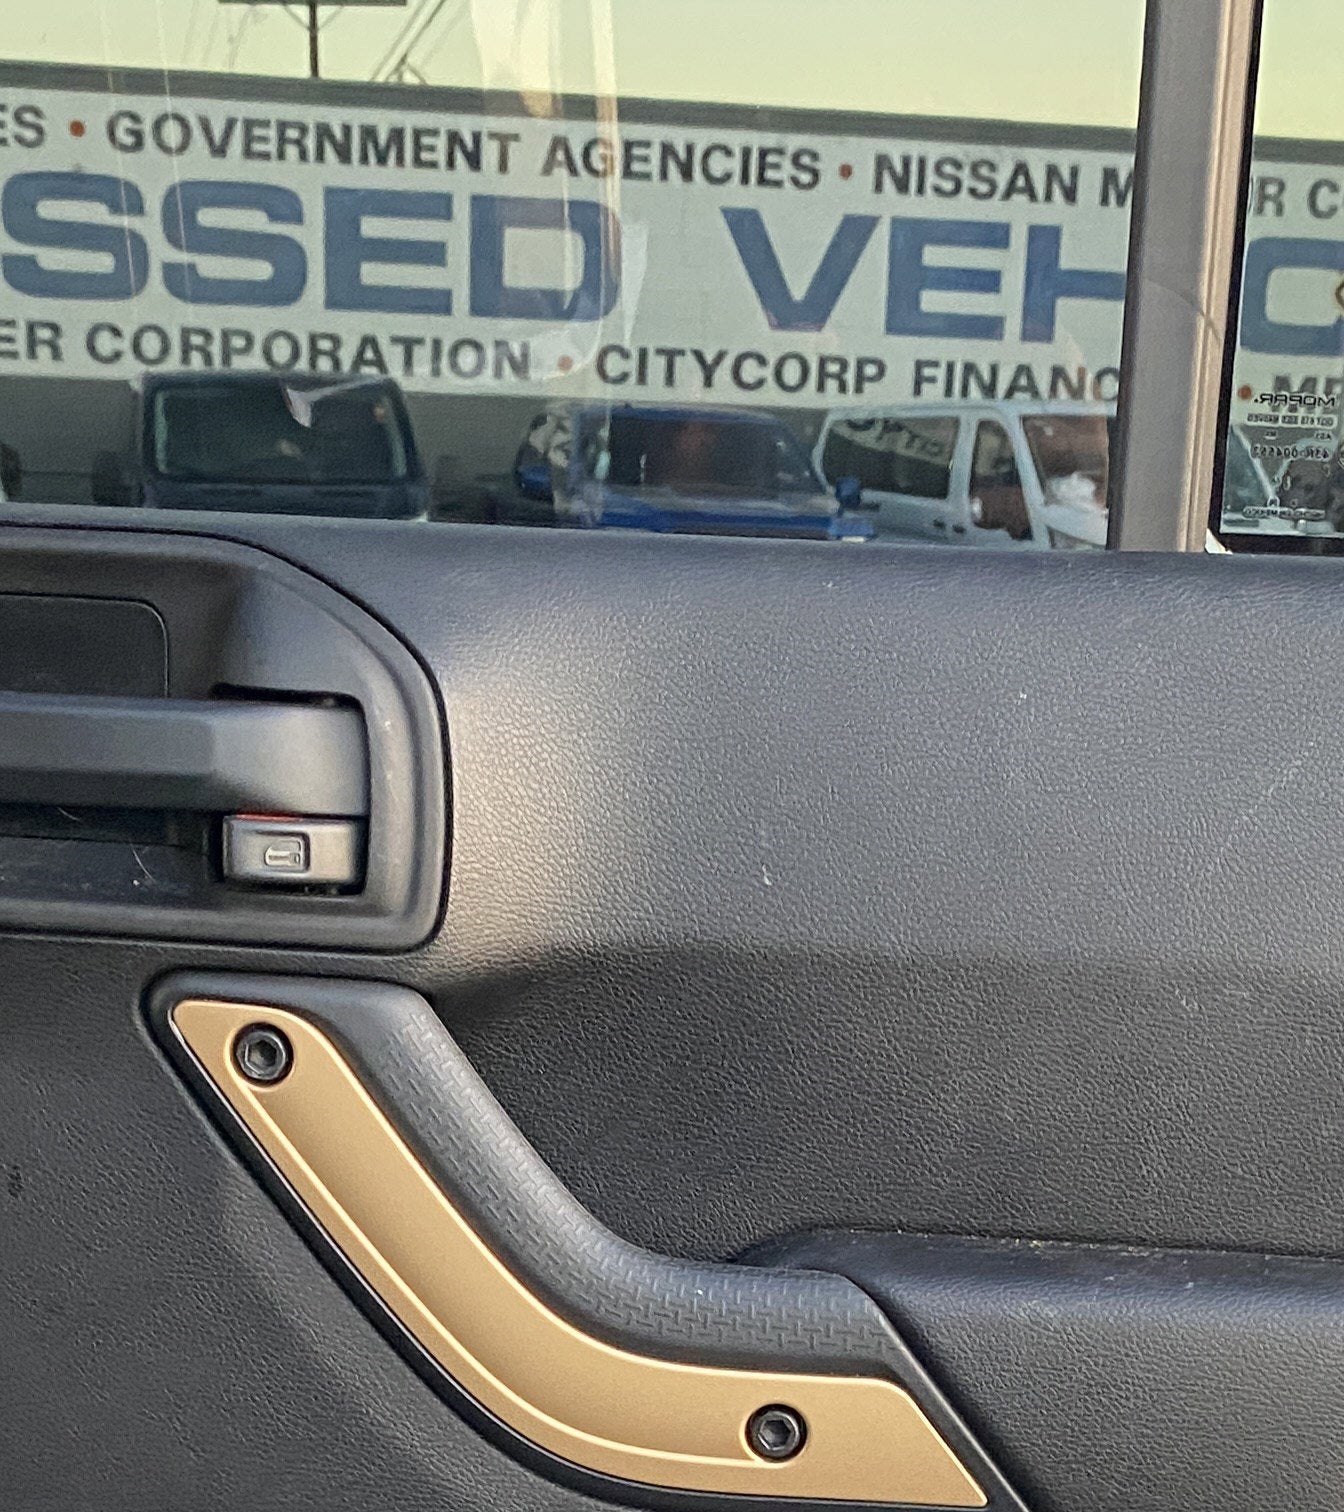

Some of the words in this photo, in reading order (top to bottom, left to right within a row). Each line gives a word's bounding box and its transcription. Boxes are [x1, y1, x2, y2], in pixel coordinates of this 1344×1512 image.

[107, 108, 519, 176] GOVERNMENT
[541, 136, 822, 191] AGENCIES
[873, 153, 1079, 206] NISSAN
[85, 321, 531, 382] CORPORATION
[596, 343, 886, 395] CITYCORP
